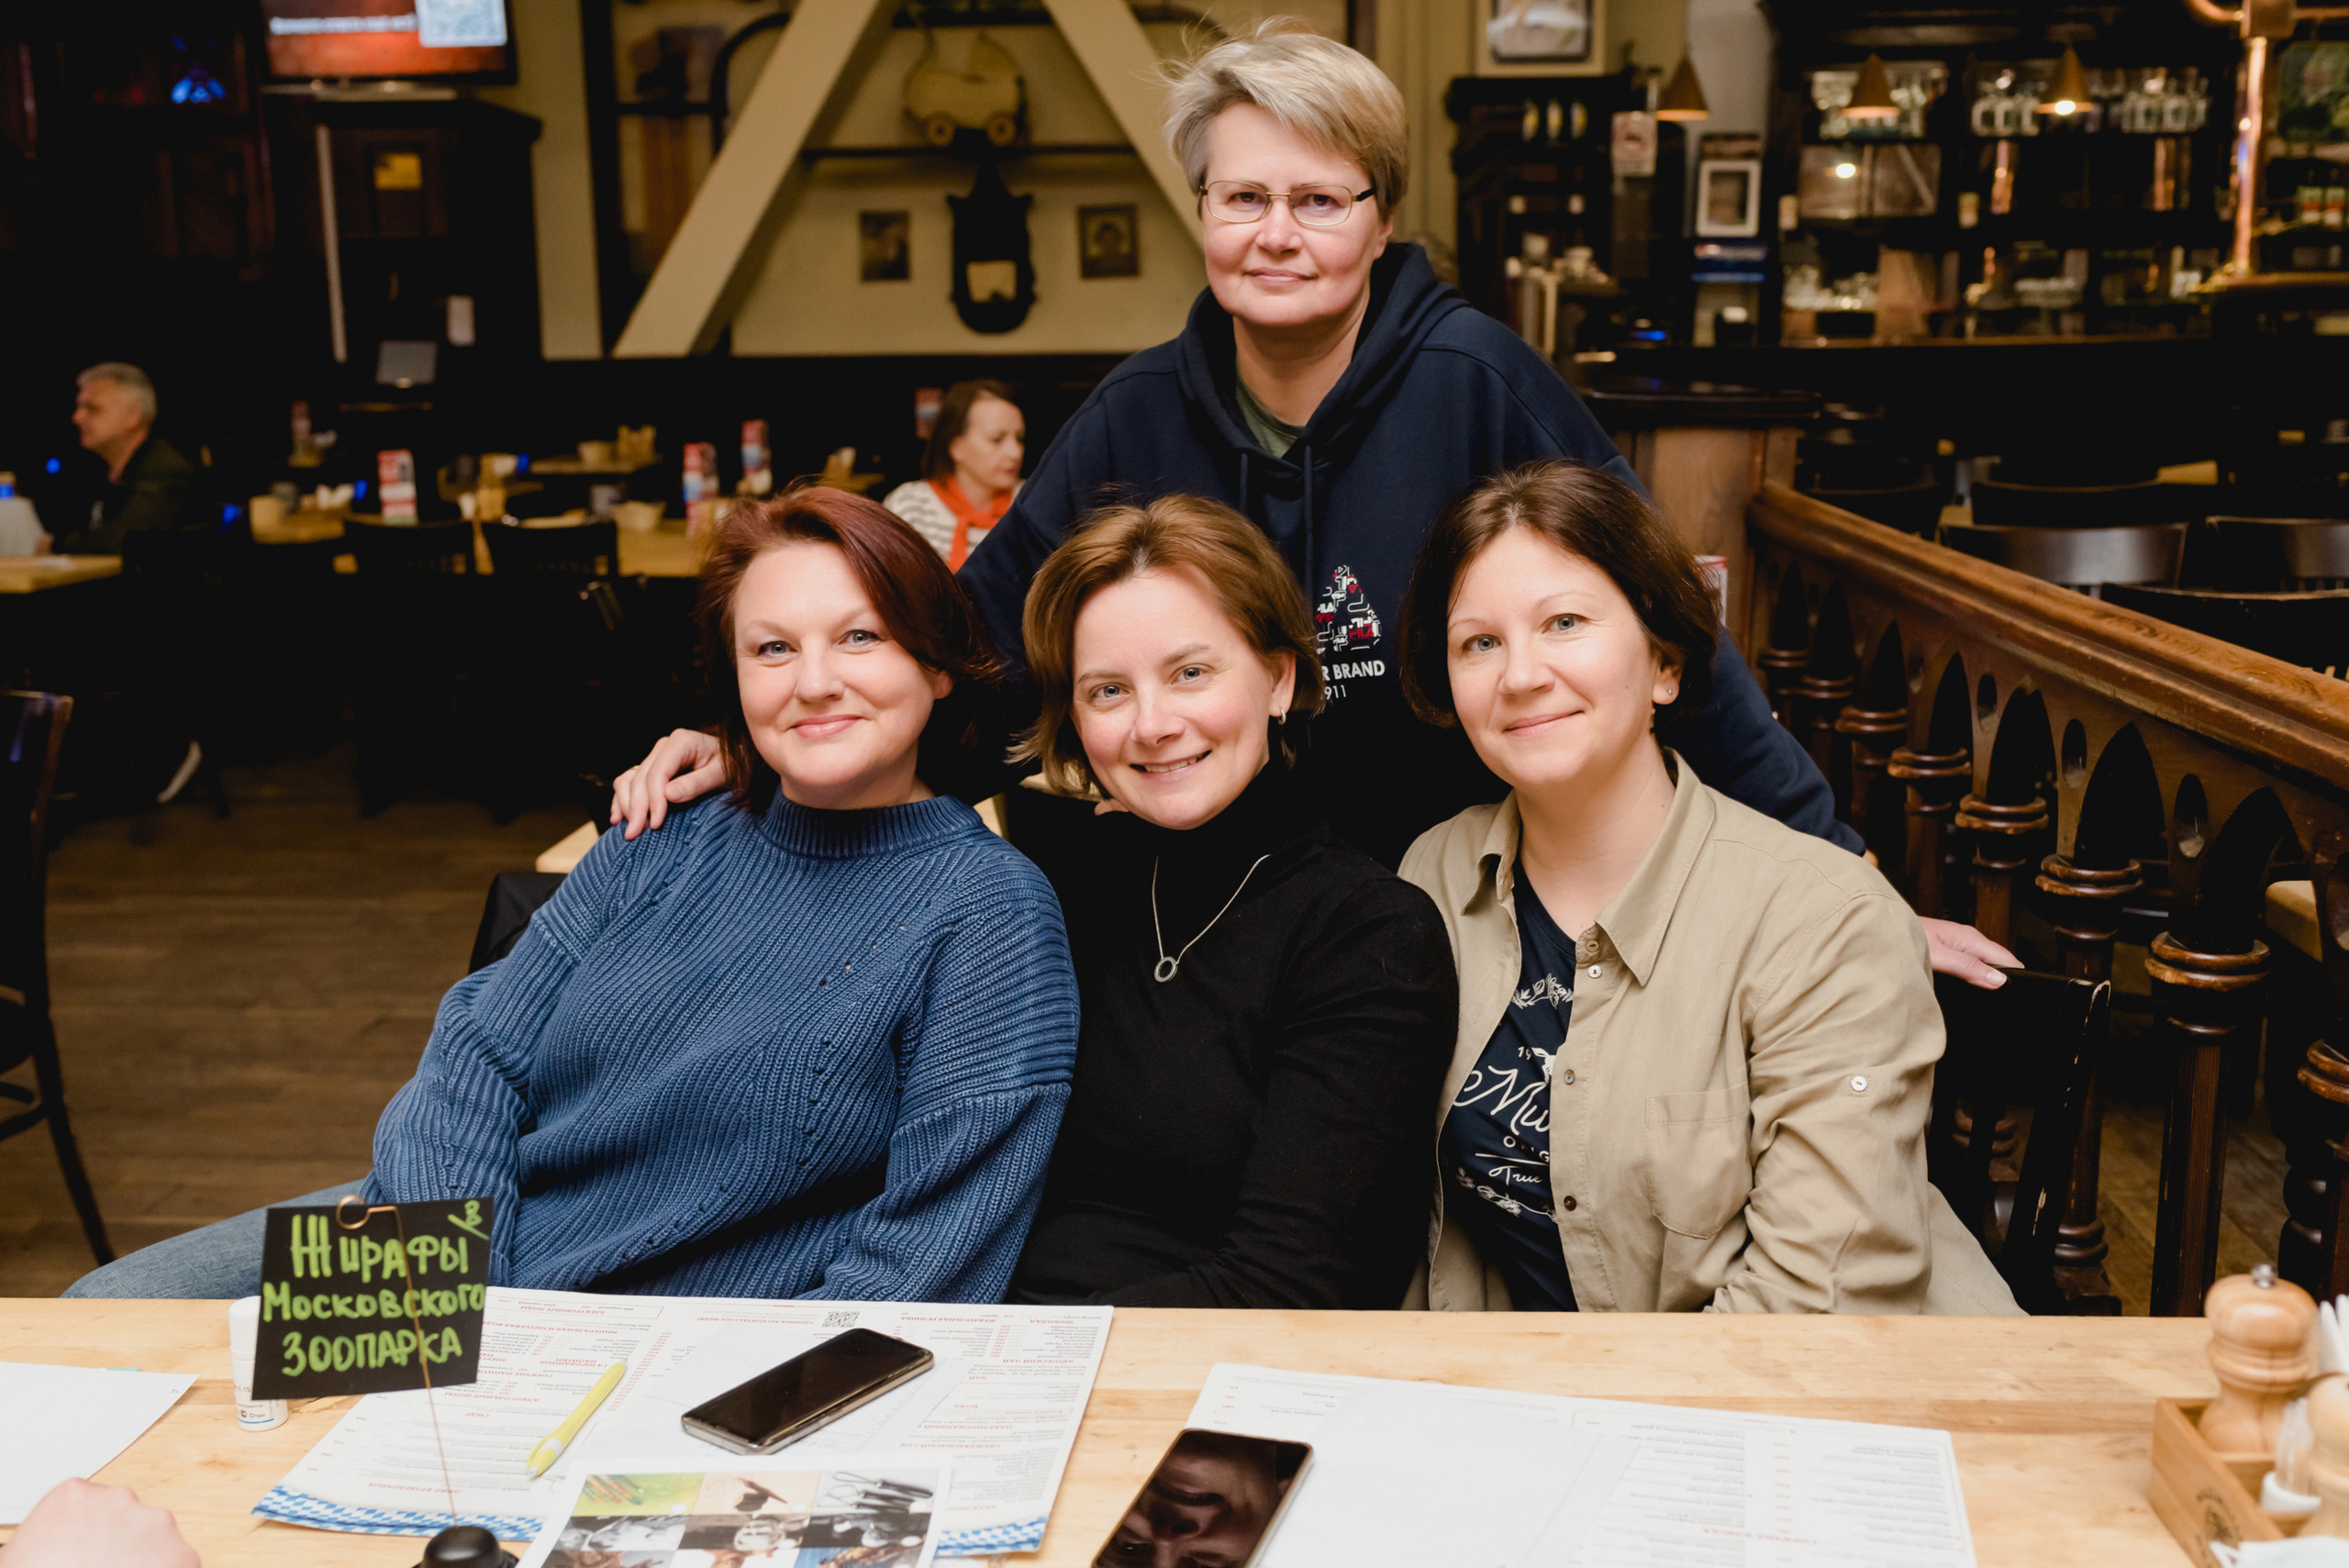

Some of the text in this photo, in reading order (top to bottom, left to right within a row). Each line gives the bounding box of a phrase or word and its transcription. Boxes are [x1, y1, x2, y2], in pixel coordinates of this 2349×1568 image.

[1332, 660, 1386, 680] BRAND
[1324, 684, 1347, 700] 911
[1488, 1165, 1543, 1186] True
[262, 1281, 486, 1322] Московского
[282, 1326, 463, 1376] ЗООПАРКА
